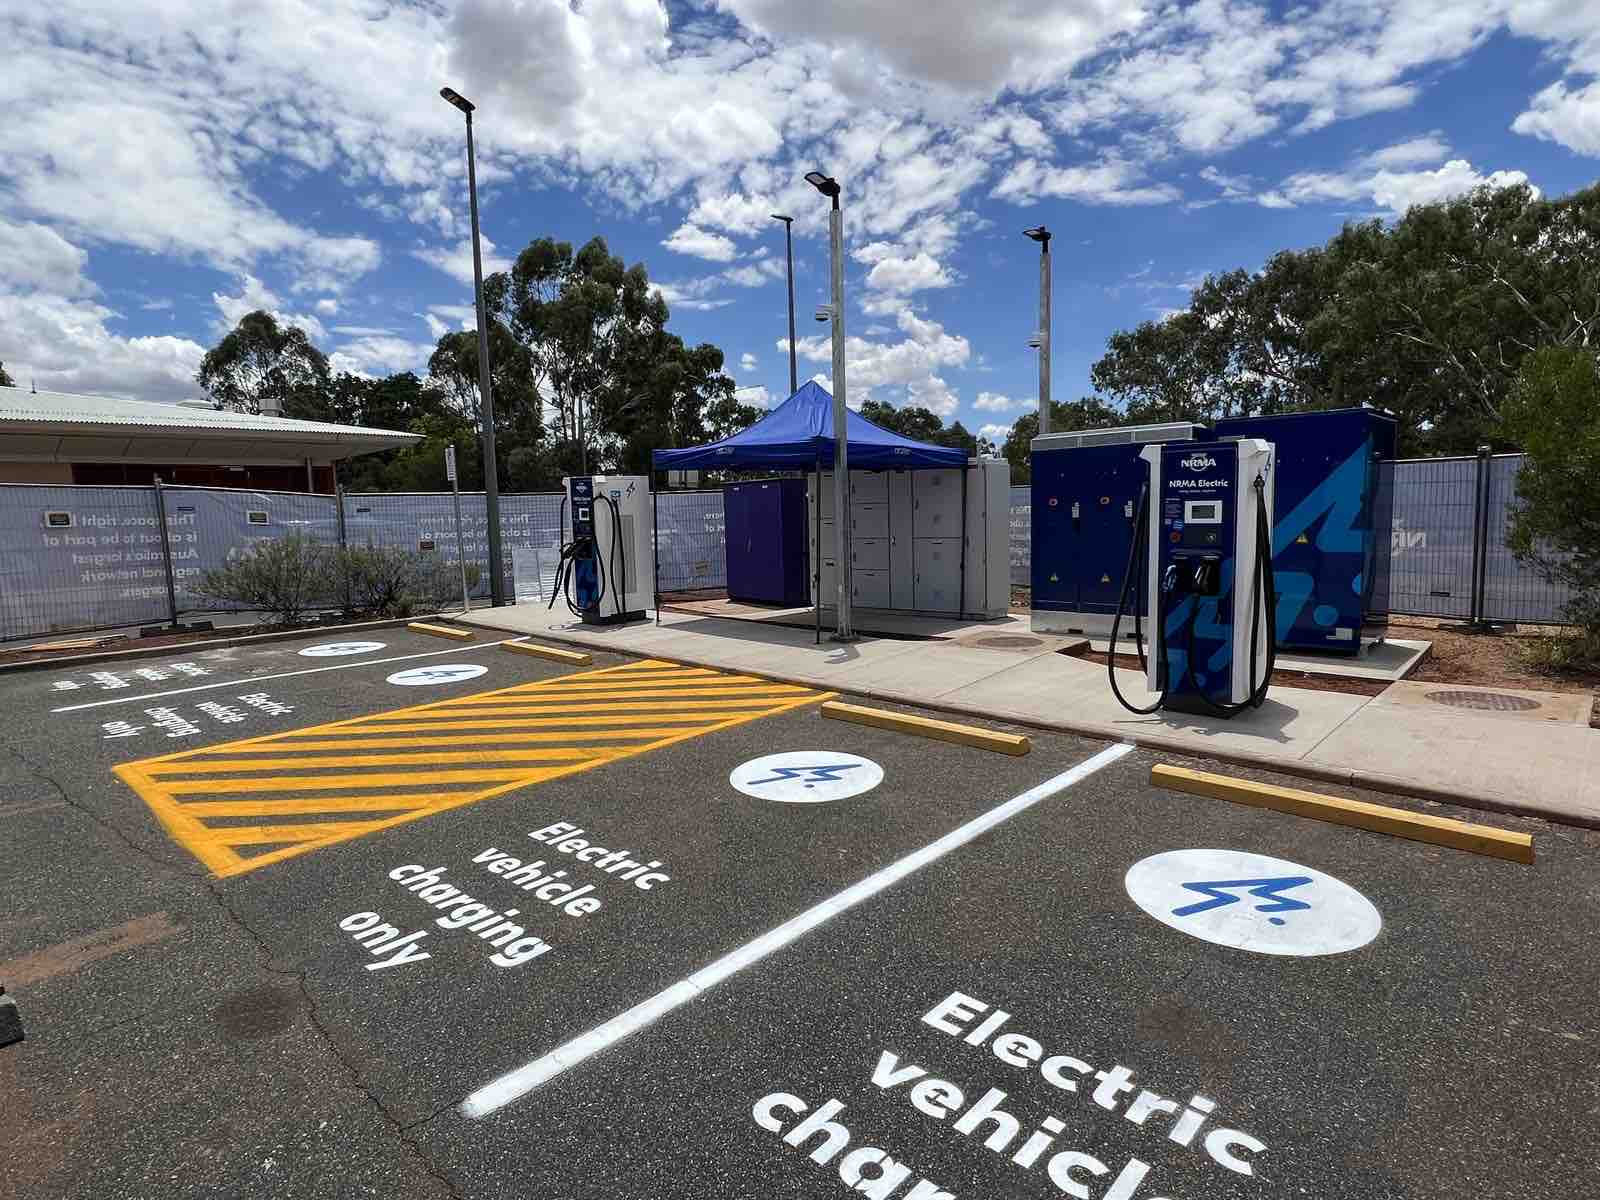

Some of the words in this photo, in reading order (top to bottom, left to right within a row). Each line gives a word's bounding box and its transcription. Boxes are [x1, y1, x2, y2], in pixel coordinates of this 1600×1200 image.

[1169, 479, 1197, 488] NRMA
[1198, 478, 1229, 488] Electric
[1180, 457, 1217, 468] NRMA
[471, 847, 602, 917] vehicle
[528, 821, 672, 891] Electric
[338, 911, 432, 972] only
[388, 863, 553, 968] charging
[920, 990, 1269, 1177] Electric
[870, 1049, 1178, 1200] vehicl
